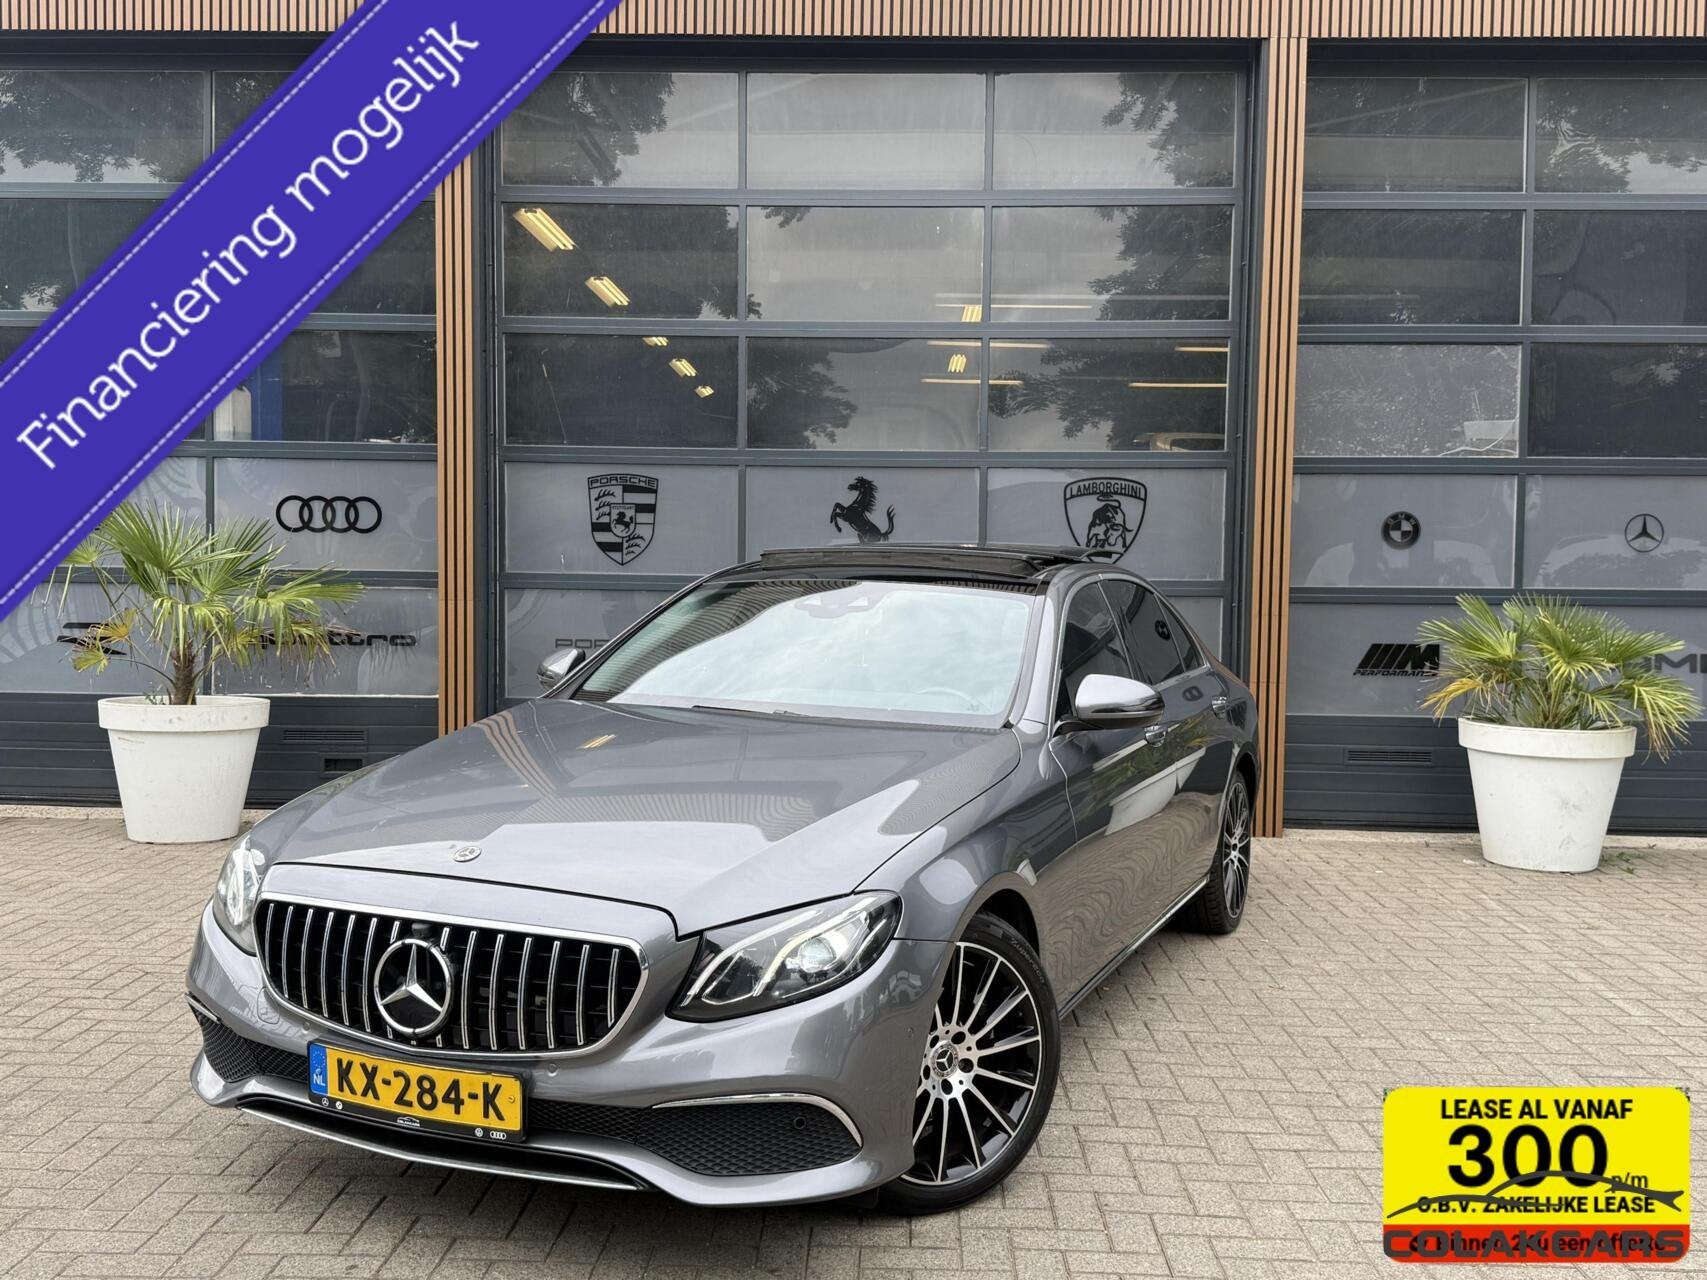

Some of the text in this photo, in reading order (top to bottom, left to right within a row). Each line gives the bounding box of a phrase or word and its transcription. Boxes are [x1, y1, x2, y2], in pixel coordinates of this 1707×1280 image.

[589, 475, 656, 488] PORSCHE
[1069, 481, 1142, 499] LAMBORGHINI
[1353, 669, 1439, 677] PERFORMAN
[313, 1073, 326, 1087] NL
[336, 1057, 505, 1121] KX-284-K
